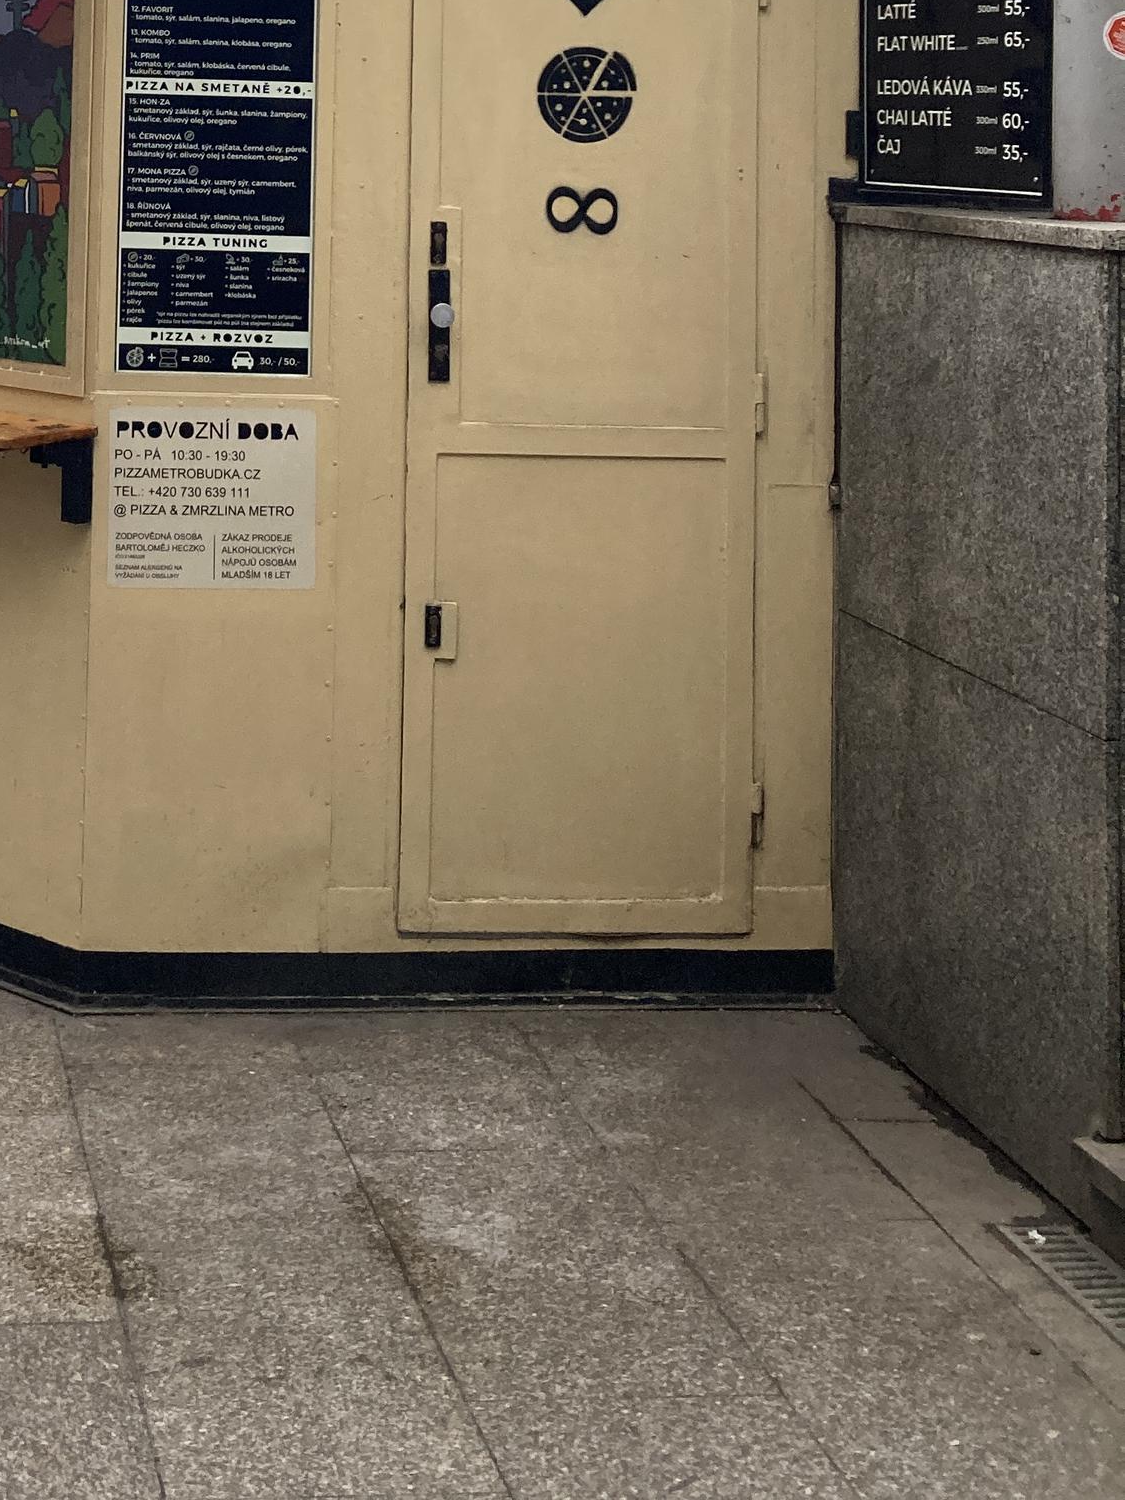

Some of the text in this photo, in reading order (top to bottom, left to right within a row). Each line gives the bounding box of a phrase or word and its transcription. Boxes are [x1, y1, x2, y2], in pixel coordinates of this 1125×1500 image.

[877, 0, 916, 19] LATTÉ
[1004, 0, 1030, 17] 55,-
[877, 36, 907, 52] FLAT
[911, 35, 955, 51] WHITE
[1004, 32, 1030, 49] 65,-
[126, 81, 168, 90] PIZZA
[175, 82, 194, 91] NA
[201, 82, 270, 93] SMETANĚ
[877, 76, 930, 95] LEDOVÁ
[933, 76, 973, 96] KÁVA
[1003, 81, 1029, 99] 55,-
[877, 110, 907, 126] CHAI
[911, 107, 952, 126] LATTÉ
[1002, 113, 1030, 131] 60,-
[139, 132, 182, 140] ČERVNOVÁ
[877, 135, 901, 154] ČAJ
[1002, 144, 1029, 162] 35,-
[163, 236, 268, 248] PIZZA TUNING
[151, 332, 194, 341] PIZZA
[213, 333, 273, 344] ROZVOZ
[116, 418, 299, 441] PROVOZNÍ DOBA
[115, 449, 133, 461] PO
[144, 447, 161, 461] PÁ
[172, 450, 203, 461] 10:30
[215, 451, 246, 462] 19:30
[114, 468, 261, 480] PIZZAMETROBUDKA.CZ
[149, 486, 176, 497] +420
[181, 487, 202, 497] 730
[205, 487, 226, 498] 639
[231, 487, 250, 498] 111
[114, 504, 295, 517] @ PIZZA & ZMRZLINA METRO
[116, 532, 171, 540] ZODPOVĚDNÁ
[221, 533, 292, 542] ZÁKAZ PRODEJE
[221, 545, 295, 554] ALKOHOLICKÝCH
[221, 558, 296, 567] NÁPOJŮ OSOBÁM
[221, 570, 261, 579] MLADŠÍM
